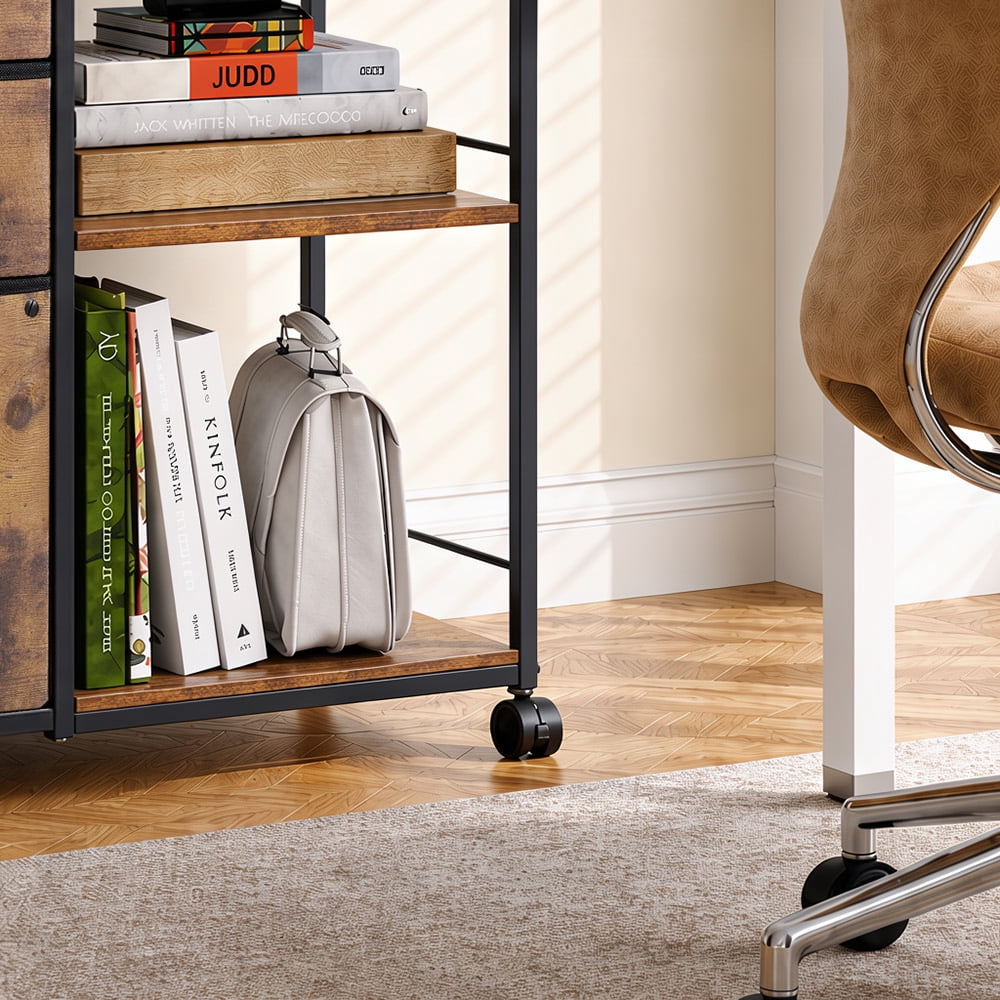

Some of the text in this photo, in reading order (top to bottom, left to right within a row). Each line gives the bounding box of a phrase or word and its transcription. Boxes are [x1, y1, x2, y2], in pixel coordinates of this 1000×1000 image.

[212, 64, 276, 89] JUDD
[173, 116, 236, 131] WHITTEN
[248, 114, 273, 128] THE
[204, 416, 233, 521] KINFOLK
